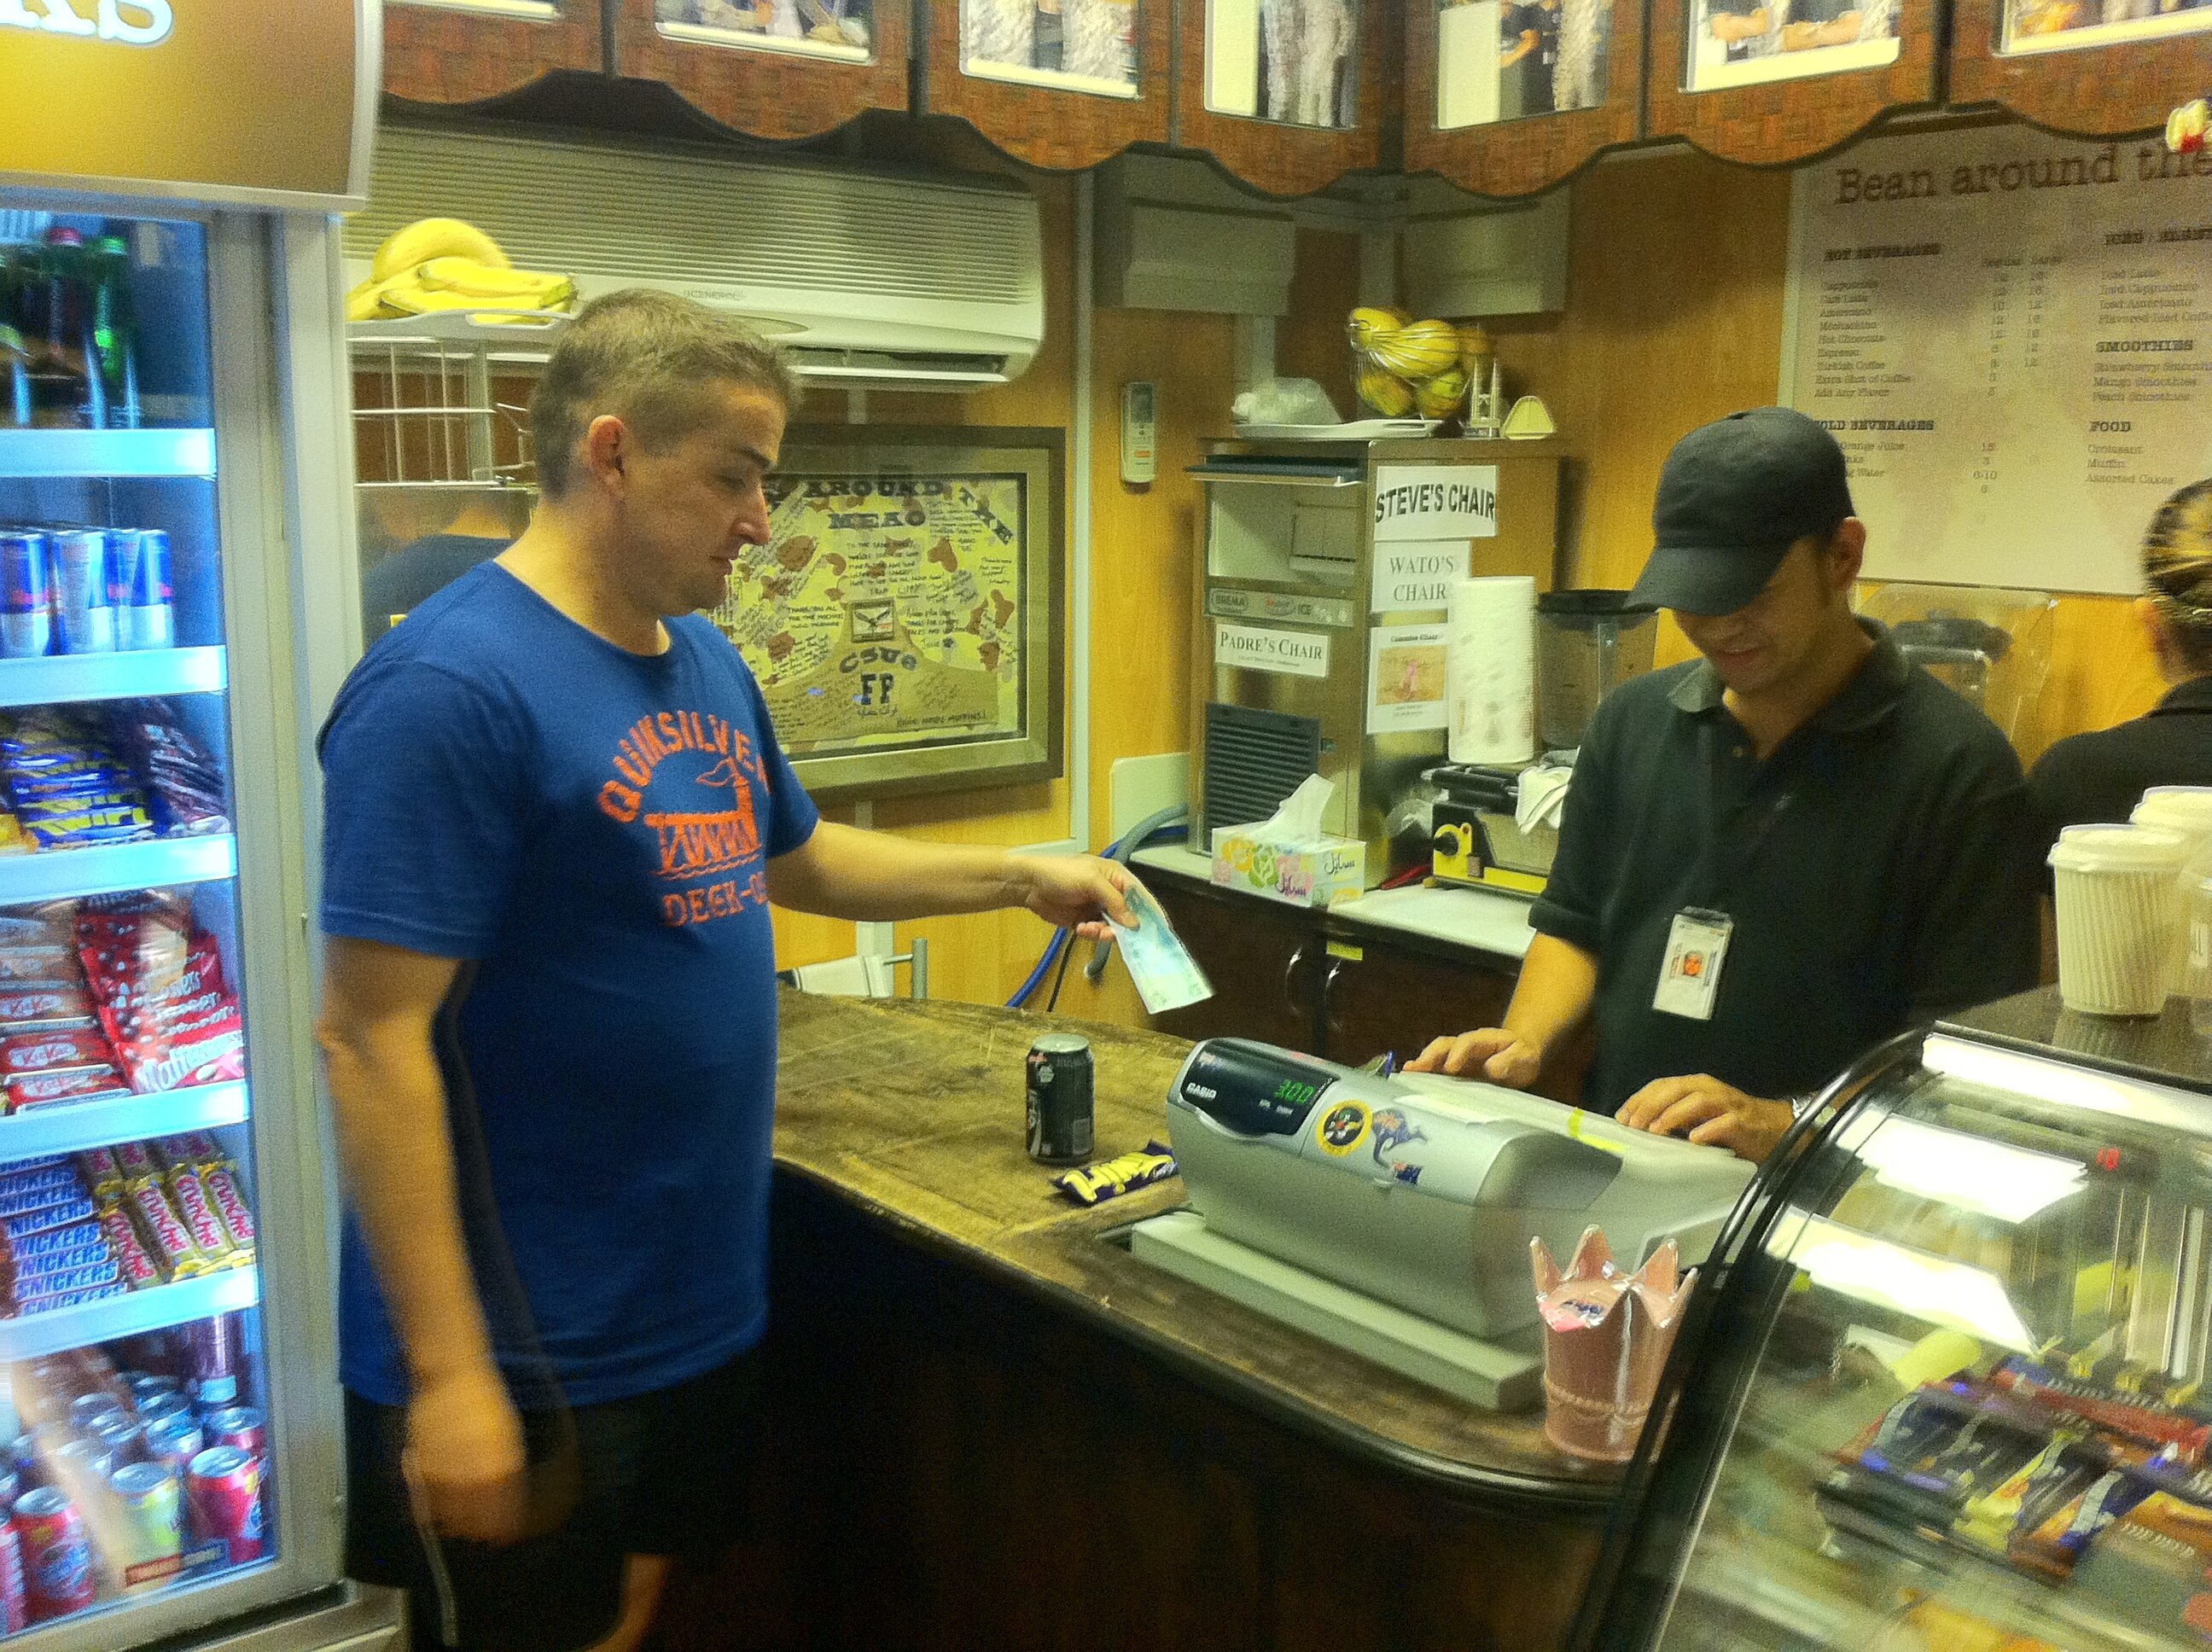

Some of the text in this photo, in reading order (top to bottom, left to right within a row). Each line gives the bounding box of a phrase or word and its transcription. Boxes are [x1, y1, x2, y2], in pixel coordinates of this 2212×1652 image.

[1835, 166, 1937, 205] Bean
[1949, 143, 2121, 195] around
[2096, 339, 2194, 353] SMOOTHIES
[1850, 420, 1936, 431] BEVERAGES
[2089, 421, 2132, 433] FOOD
[1375, 483, 1497, 523] STEVE'S CHAIR
[1389, 556, 1455, 575] WATO'S
[1393, 583, 1447, 602] CHAIR
[1220, 631, 1323, 660] PADRE'S CHAIR
[1186, 1082, 1218, 1102] CASIO
